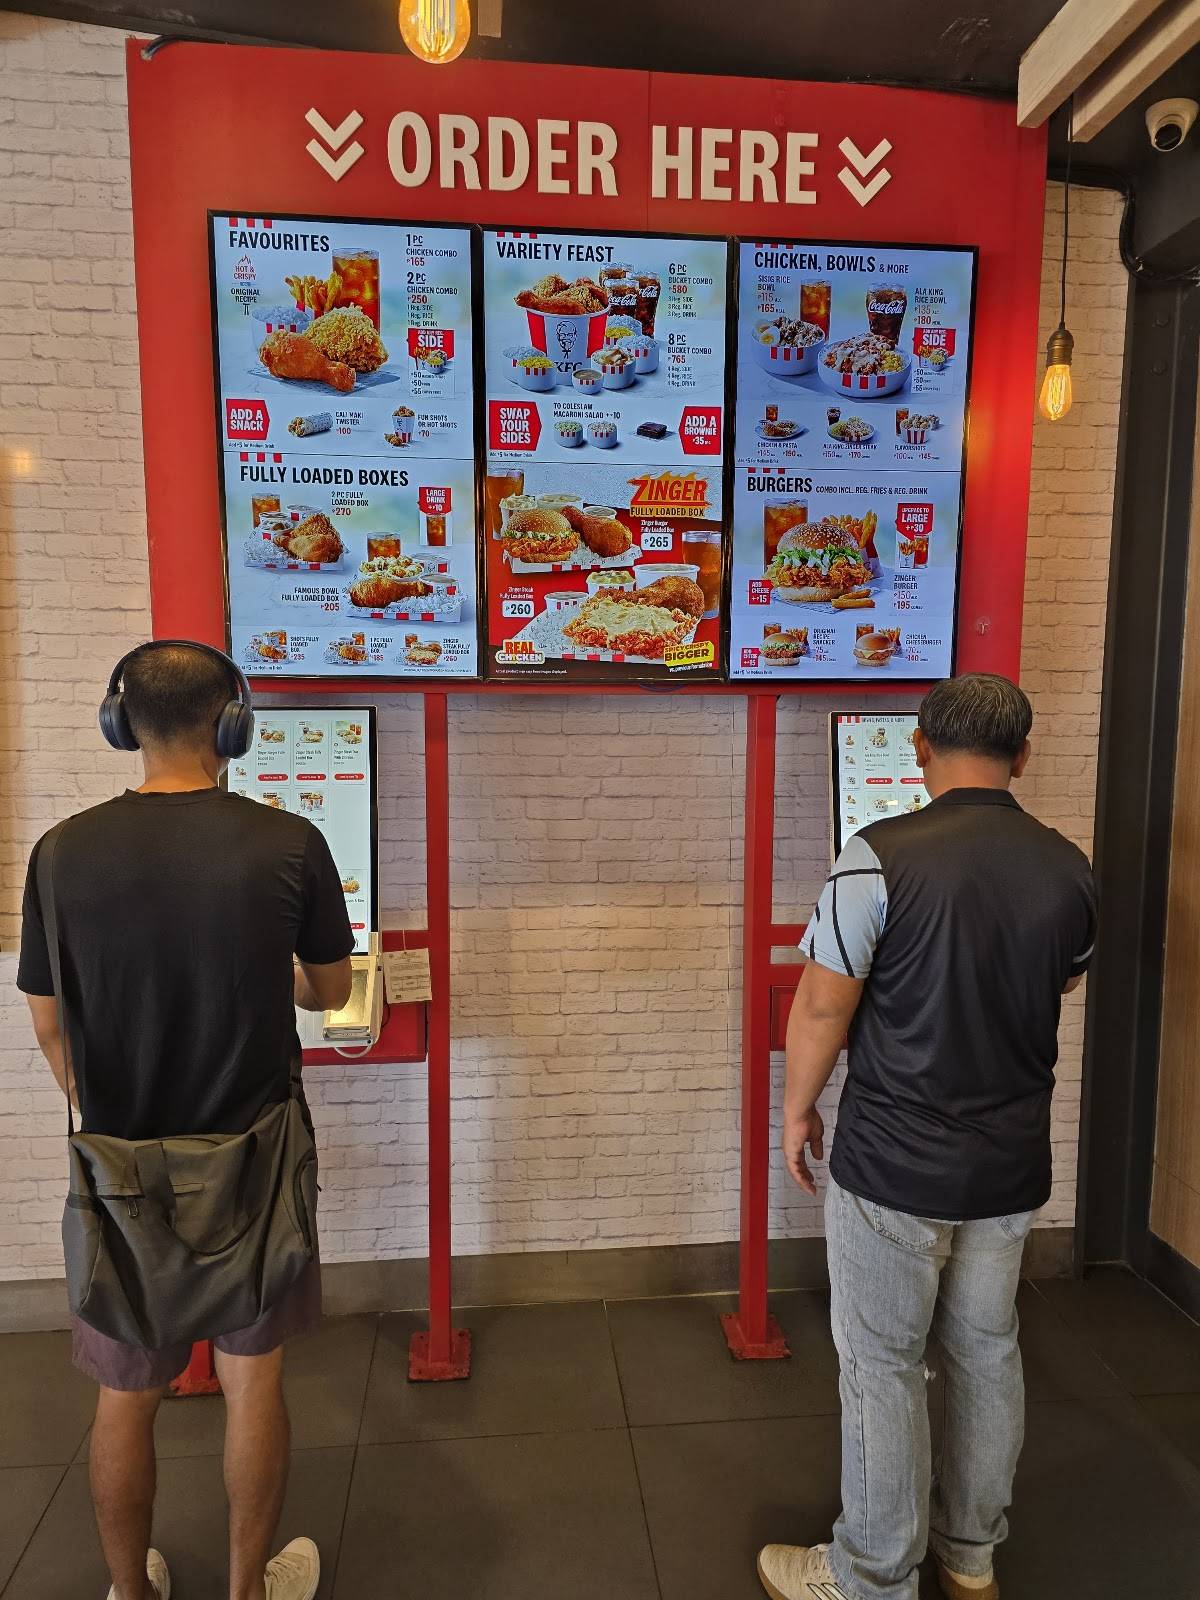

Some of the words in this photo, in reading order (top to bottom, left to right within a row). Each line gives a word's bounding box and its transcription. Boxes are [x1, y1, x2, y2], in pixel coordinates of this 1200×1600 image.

[386, 110, 620, 197] ORDER
[651, 124, 820, 205] HERE
[229, 231, 330, 253] FAVOURITES
[406, 234, 411, 246] 1
[413, 235, 424, 244] PC
[406, 248, 434, 257] CHICKEN
[435, 250, 458, 258] COMBO
[496, 241, 563, 261] VARIETY
[567, 244, 615, 263] FEAST
[755, 251, 823, 273] CHICKEN,
[826, 254, 876, 273] BOWLS
[878, 263, 885, 273] &
[887, 264, 909, 274] MORE
[669, 263, 676, 275] 6
[678, 264, 687, 273] PC
[234, 273, 256, 281] CRISPY
[407, 272, 414, 285] 2
[416, 273, 427, 282] PC
[776, 276, 791, 284] RICE
[231, 288, 260, 296] ORIGINAL
[407, 286, 435, 294] CHICKEN
[436, 288, 458, 296] COMBO
[929, 288, 944, 296] KING
[915, 296, 929, 304] RICE
[929, 296, 947, 305] BOWL
[868, 299, 905, 315] Coca-Cola
[418, 335, 444, 348] SIDE
[668, 333, 675, 345] 8
[677, 335, 687, 343] PC
[923, 334, 946, 346] SIDE
[554, 361, 583, 373] KFC
[230, 408, 253, 420] ADD
[256, 409, 264, 421] A
[500, 408, 531, 420] SWAP
[584, 411, 604, 419] SALAD
[230, 420, 264, 432] SNACK
[500, 420, 529, 432] YOUR
[685, 416, 707, 427] ADD
[710, 416, 717, 428] A
[685, 427, 717, 436] BROWNIE
[500, 432, 531, 444] SIDES
[240, 466, 287, 483] FULLY
[292, 467, 354, 485] LOADED
[359, 469, 409, 487] BOXES
[747, 477, 813, 493] BURGERS
[815, 486, 838, 494] COMBO
[855, 486, 870, 494] REG.
[870, 487, 888, 495] FRIES
[888, 487, 893, 495] &
[894, 487, 908, 495] REG.
[909, 487, 928, 495] DRINK
[426, 489, 446, 497] LARGE
[627, 479, 711, 506] ZINGER
[356, 499, 369, 507] BOX
[426, 496, 446, 504] DRINK
[631, 507, 654, 516] FULLY
[656, 508, 686, 516] LOADED
[689, 508, 705, 517] BOX
[902, 513, 929, 523] LARGE
[505, 641, 535, 654] REAL
[499, 653, 542, 662] CHICKEN
[665, 648, 711, 662] BIGGER
